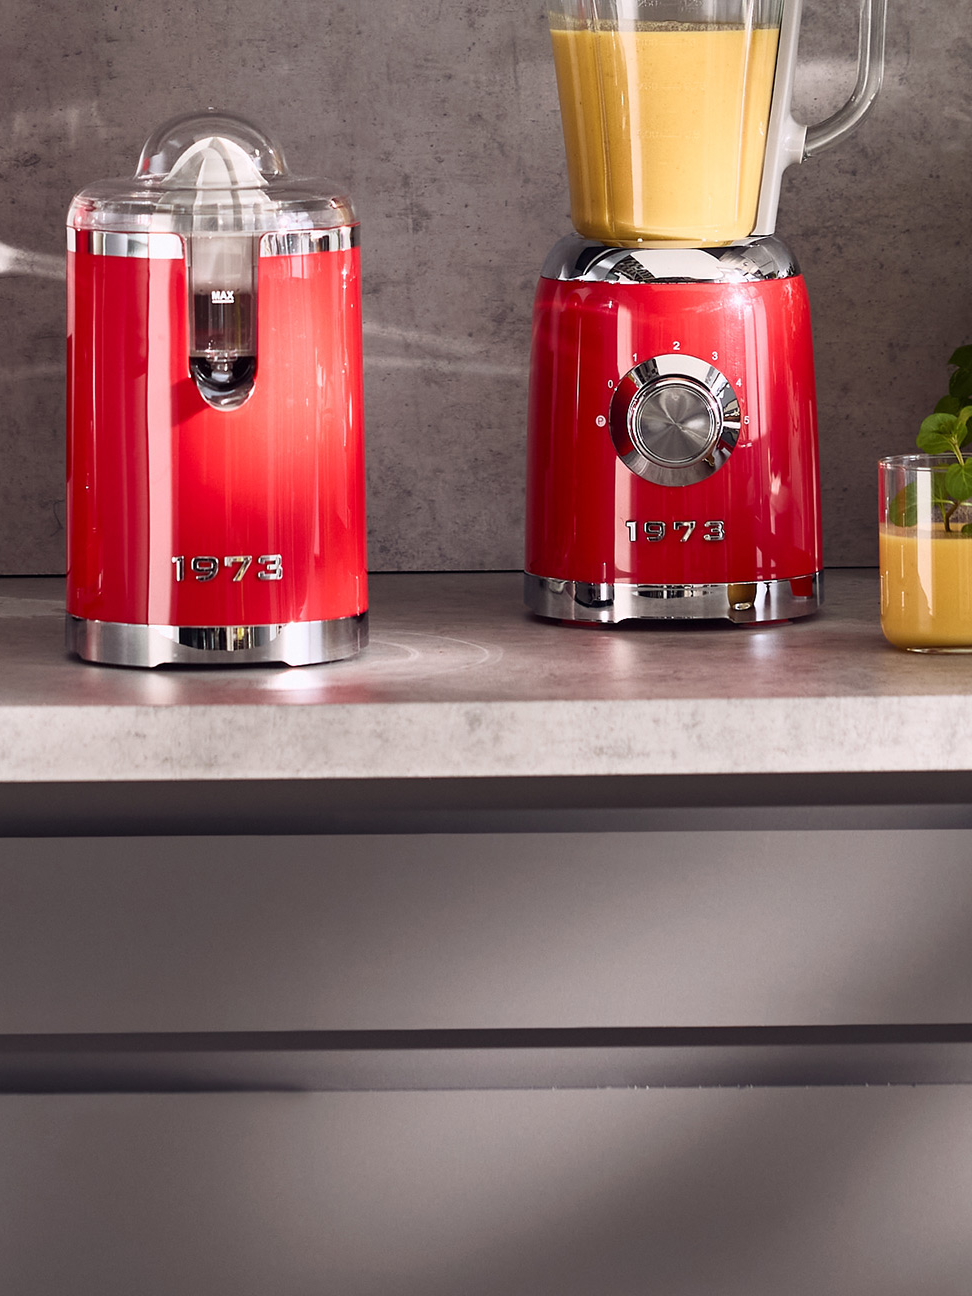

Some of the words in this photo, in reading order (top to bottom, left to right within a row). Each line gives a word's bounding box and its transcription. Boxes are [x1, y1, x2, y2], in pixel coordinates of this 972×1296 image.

[211, 290, 234, 301] MAX
[607, 380, 613, 388] 0
[632, 353, 637, 362] 1
[673, 341, 680, 350] 2
[711, 352, 718, 360] 3
[736, 378, 742, 387] 4
[744, 416, 750, 425] 5
[625, 520, 726, 542] 1973
[171, 554, 283, 582] 1973
